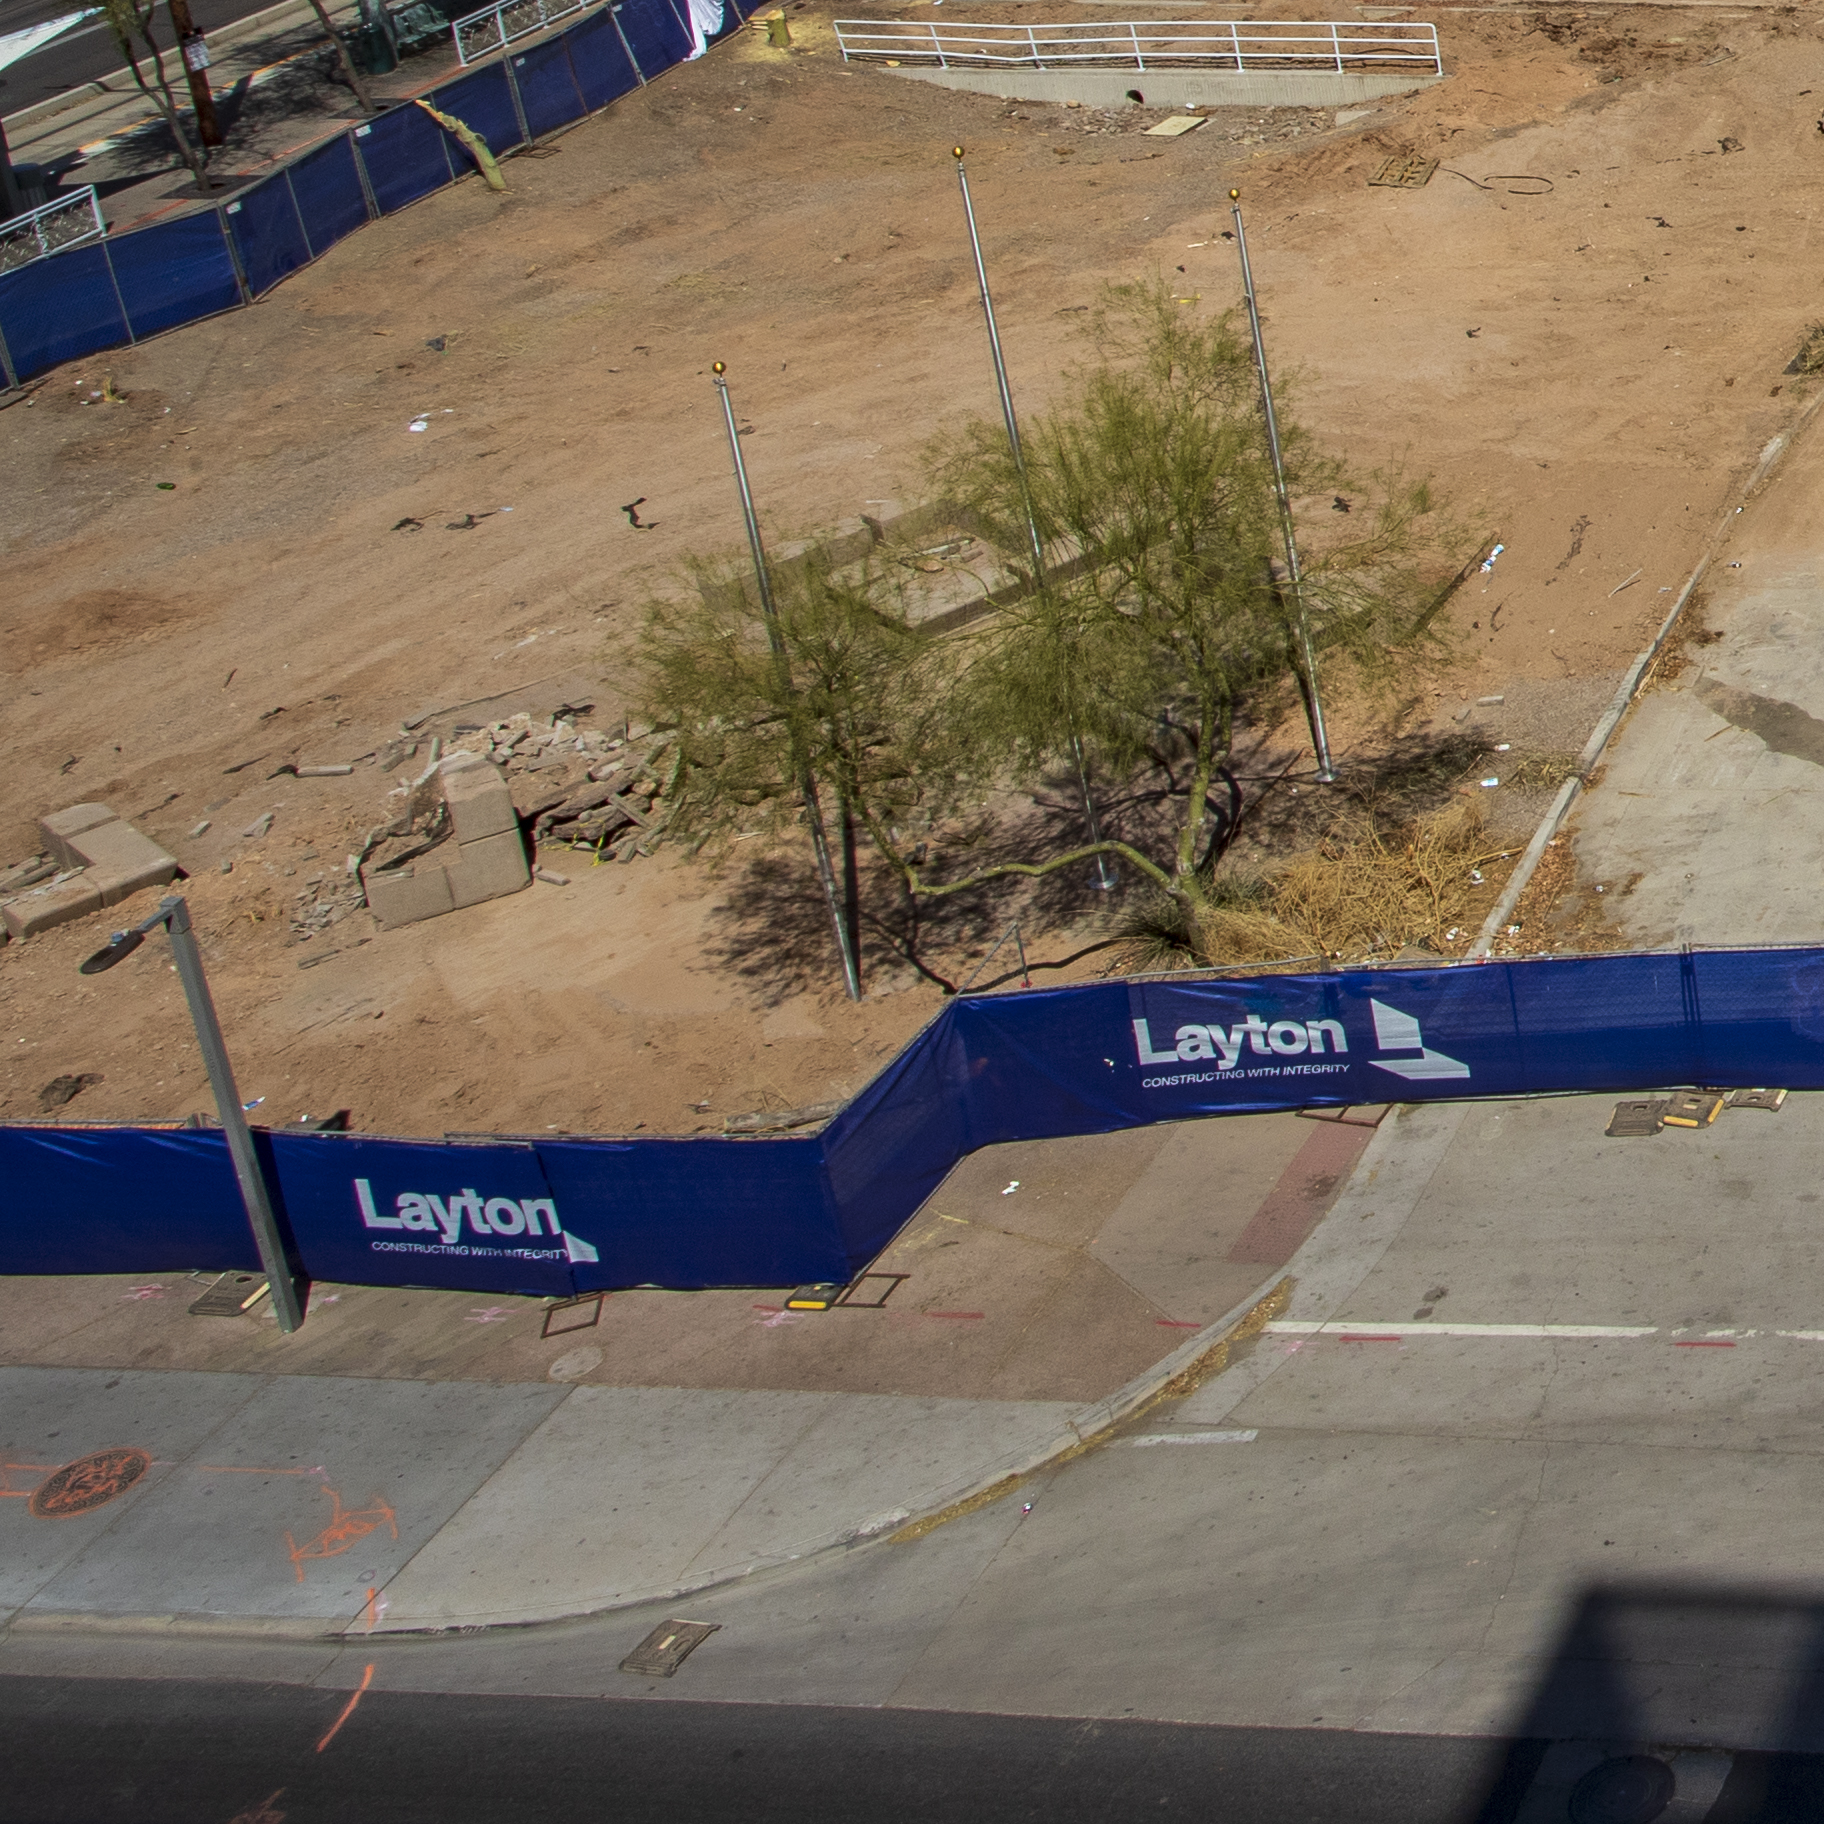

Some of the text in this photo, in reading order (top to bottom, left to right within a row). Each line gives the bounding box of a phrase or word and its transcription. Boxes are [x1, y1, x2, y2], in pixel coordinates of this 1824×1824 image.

[1131, 1013, 1350, 1071] Layton
[1141, 1062, 1351, 1089] CONSTRUCTING WITH INTEGRITY
[354, 1177, 562, 1244] Layton
[371, 1240, 469, 1257] CONSTRUCTING
[471, 1245, 503, 1258] WITH
